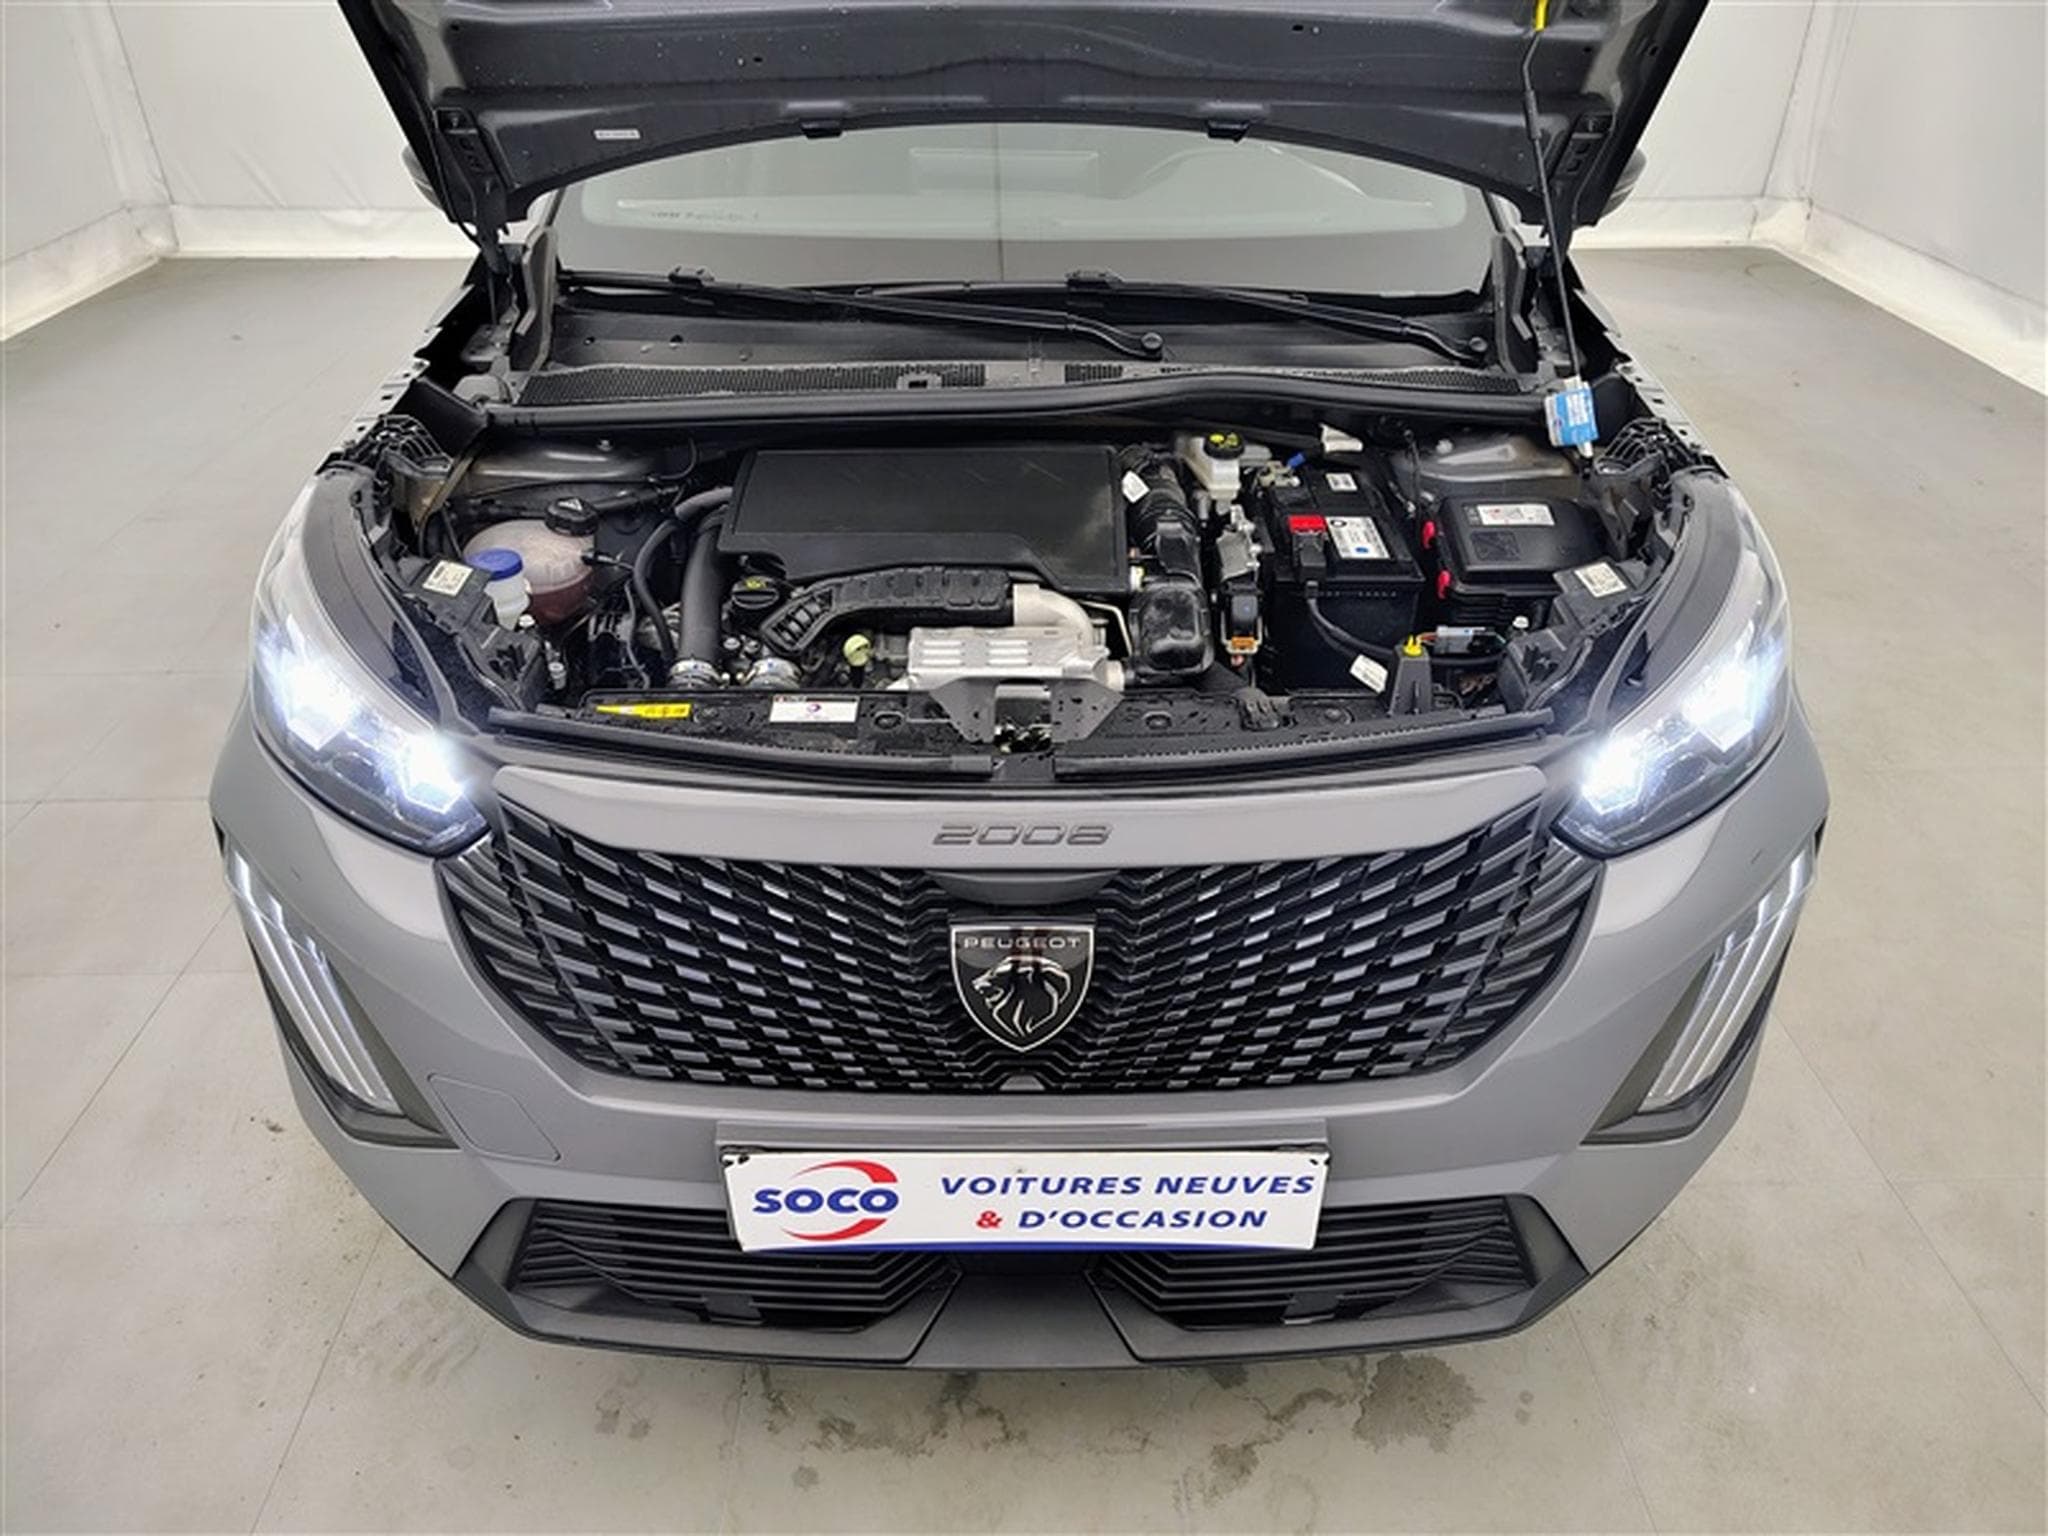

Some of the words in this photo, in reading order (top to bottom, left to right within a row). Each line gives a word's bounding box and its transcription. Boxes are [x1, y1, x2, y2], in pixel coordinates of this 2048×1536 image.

[933, 825, 1113, 846] 2008
[963, 936, 1081, 949] PEUGEOT
[941, 1176, 1142, 1195] VOITURES
[1154, 1175, 1315, 1194] NEUVES
[752, 1188, 899, 1214] SOCO
[976, 1210, 1003, 1229] &
[1018, 1210, 1267, 1229] D'OCCASION
